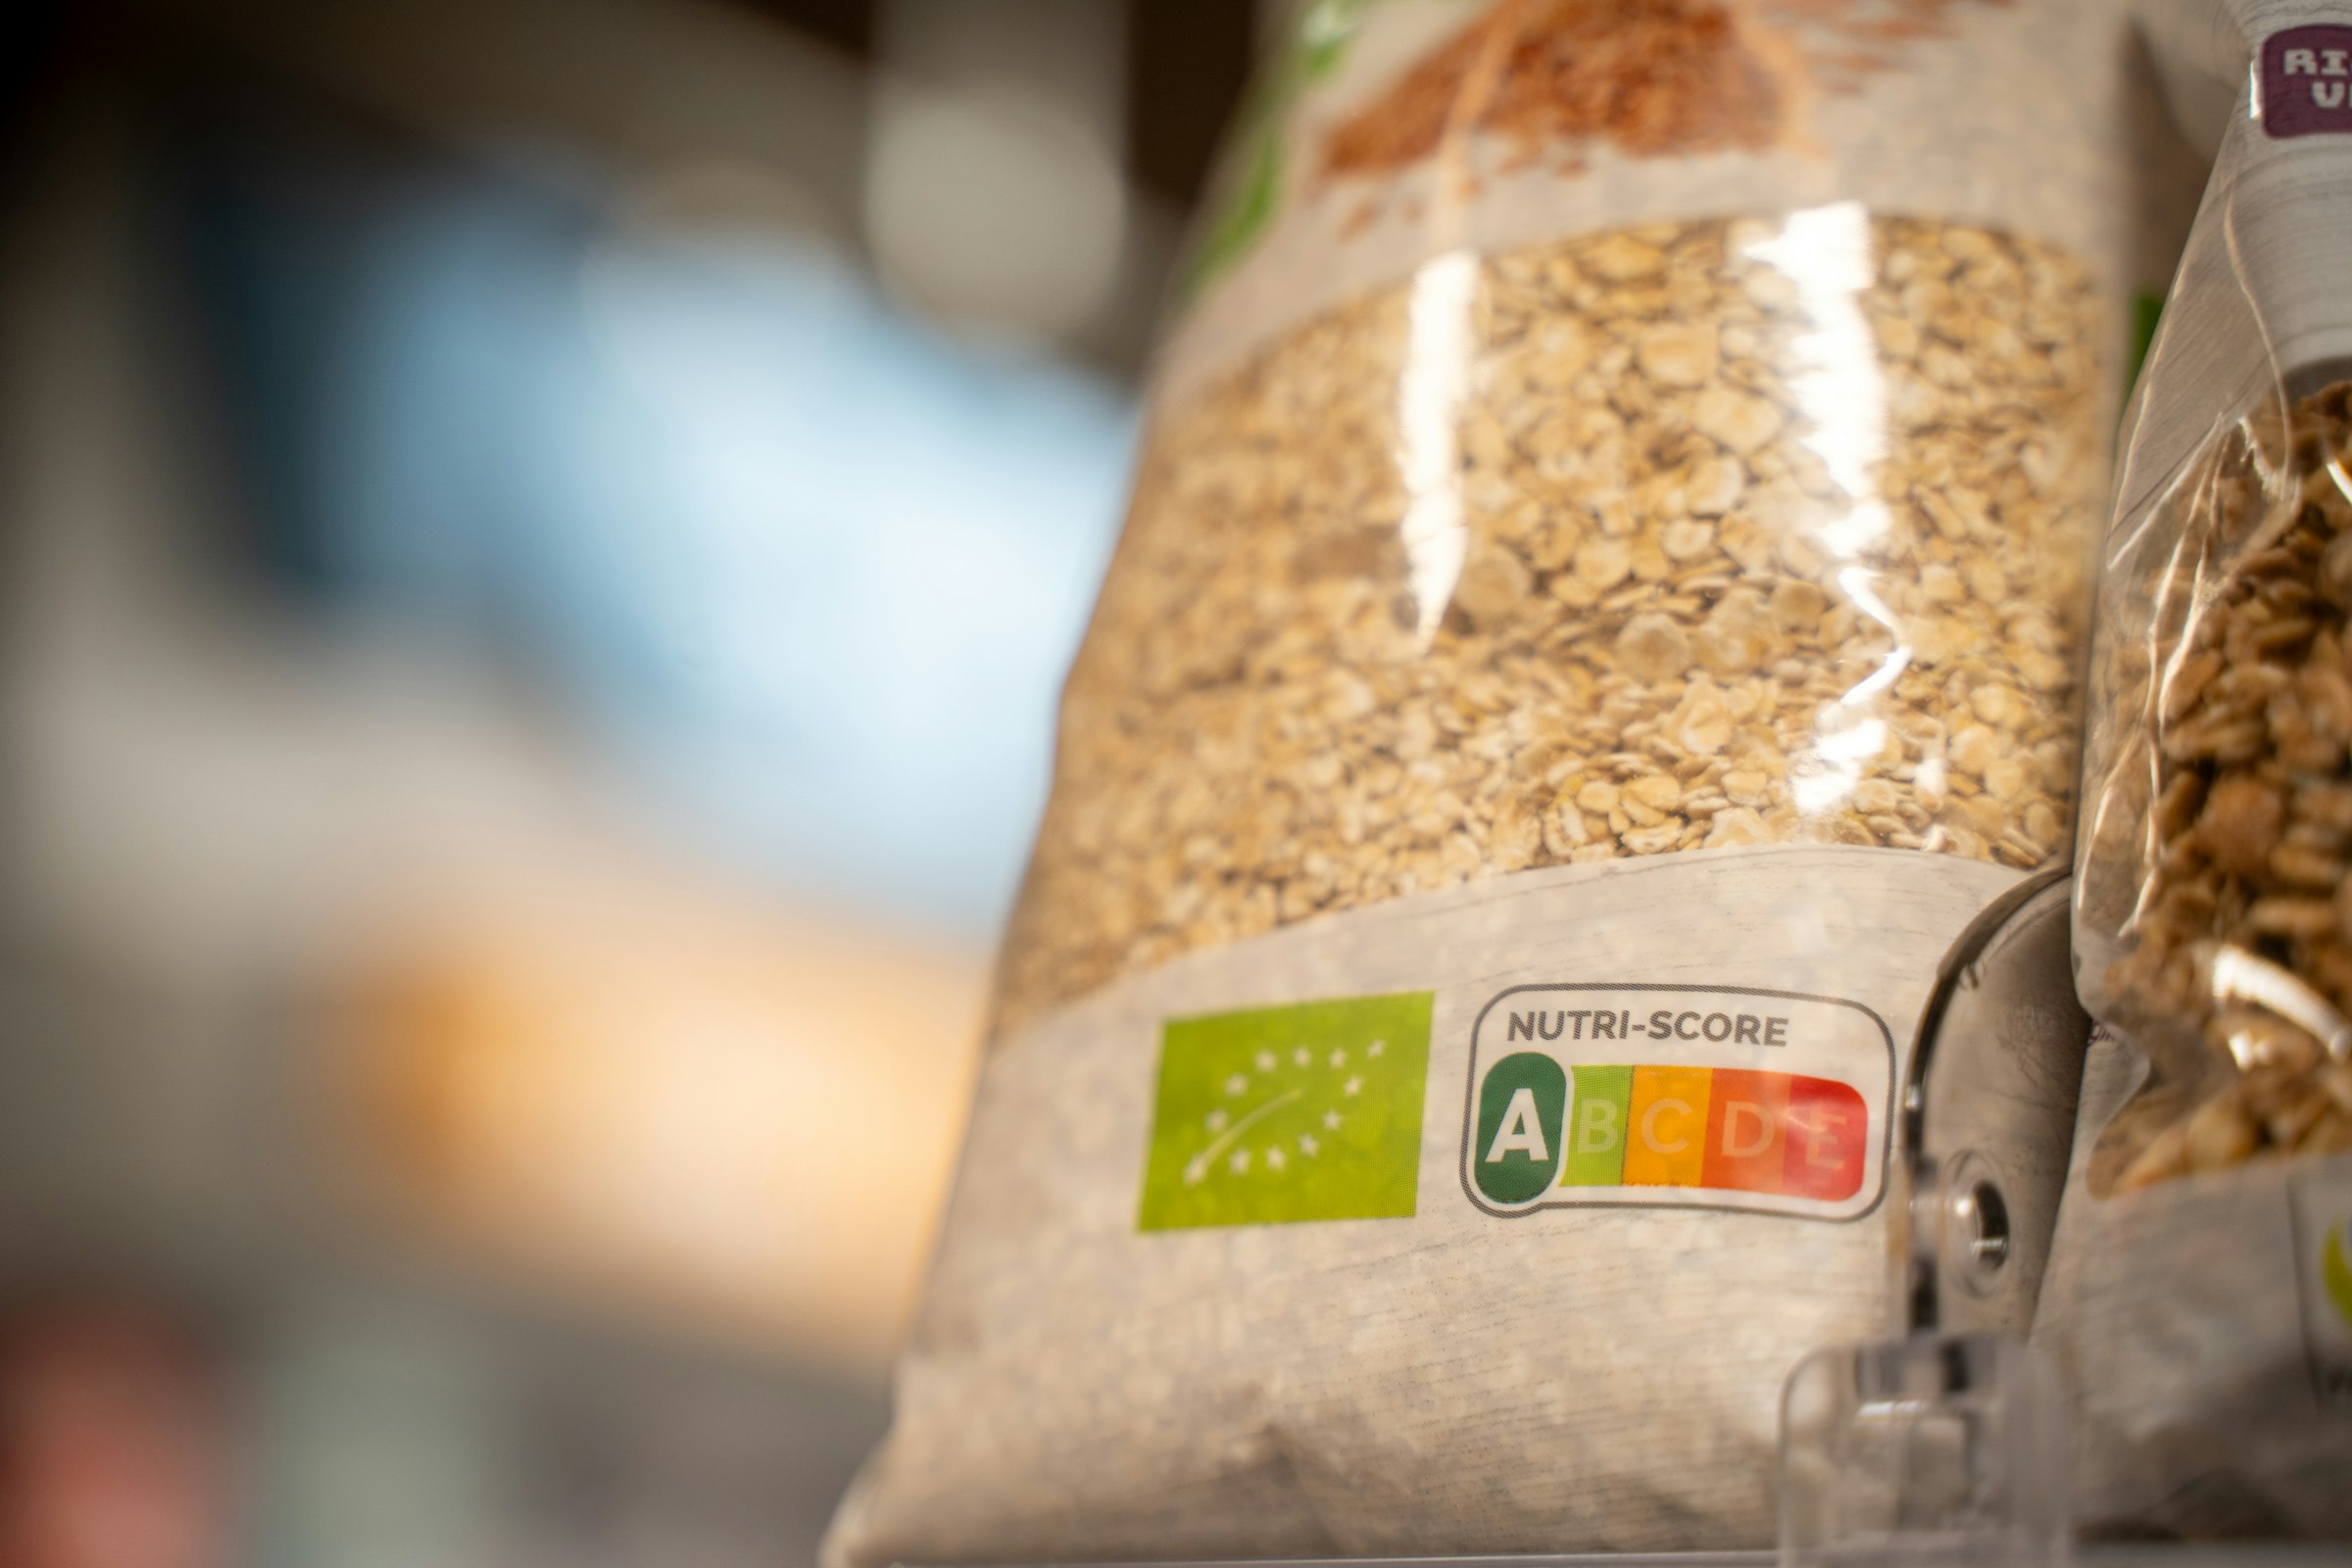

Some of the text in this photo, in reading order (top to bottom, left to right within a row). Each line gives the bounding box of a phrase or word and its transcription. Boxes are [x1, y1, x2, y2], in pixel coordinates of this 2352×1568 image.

[2284, 50, 2352, 75] RI
[2311, 82, 2352, 108] V
[1507, 1010, 1789, 1047] NUTRI-SCORE
[1485, 1088, 1847, 1170] A B C D E
